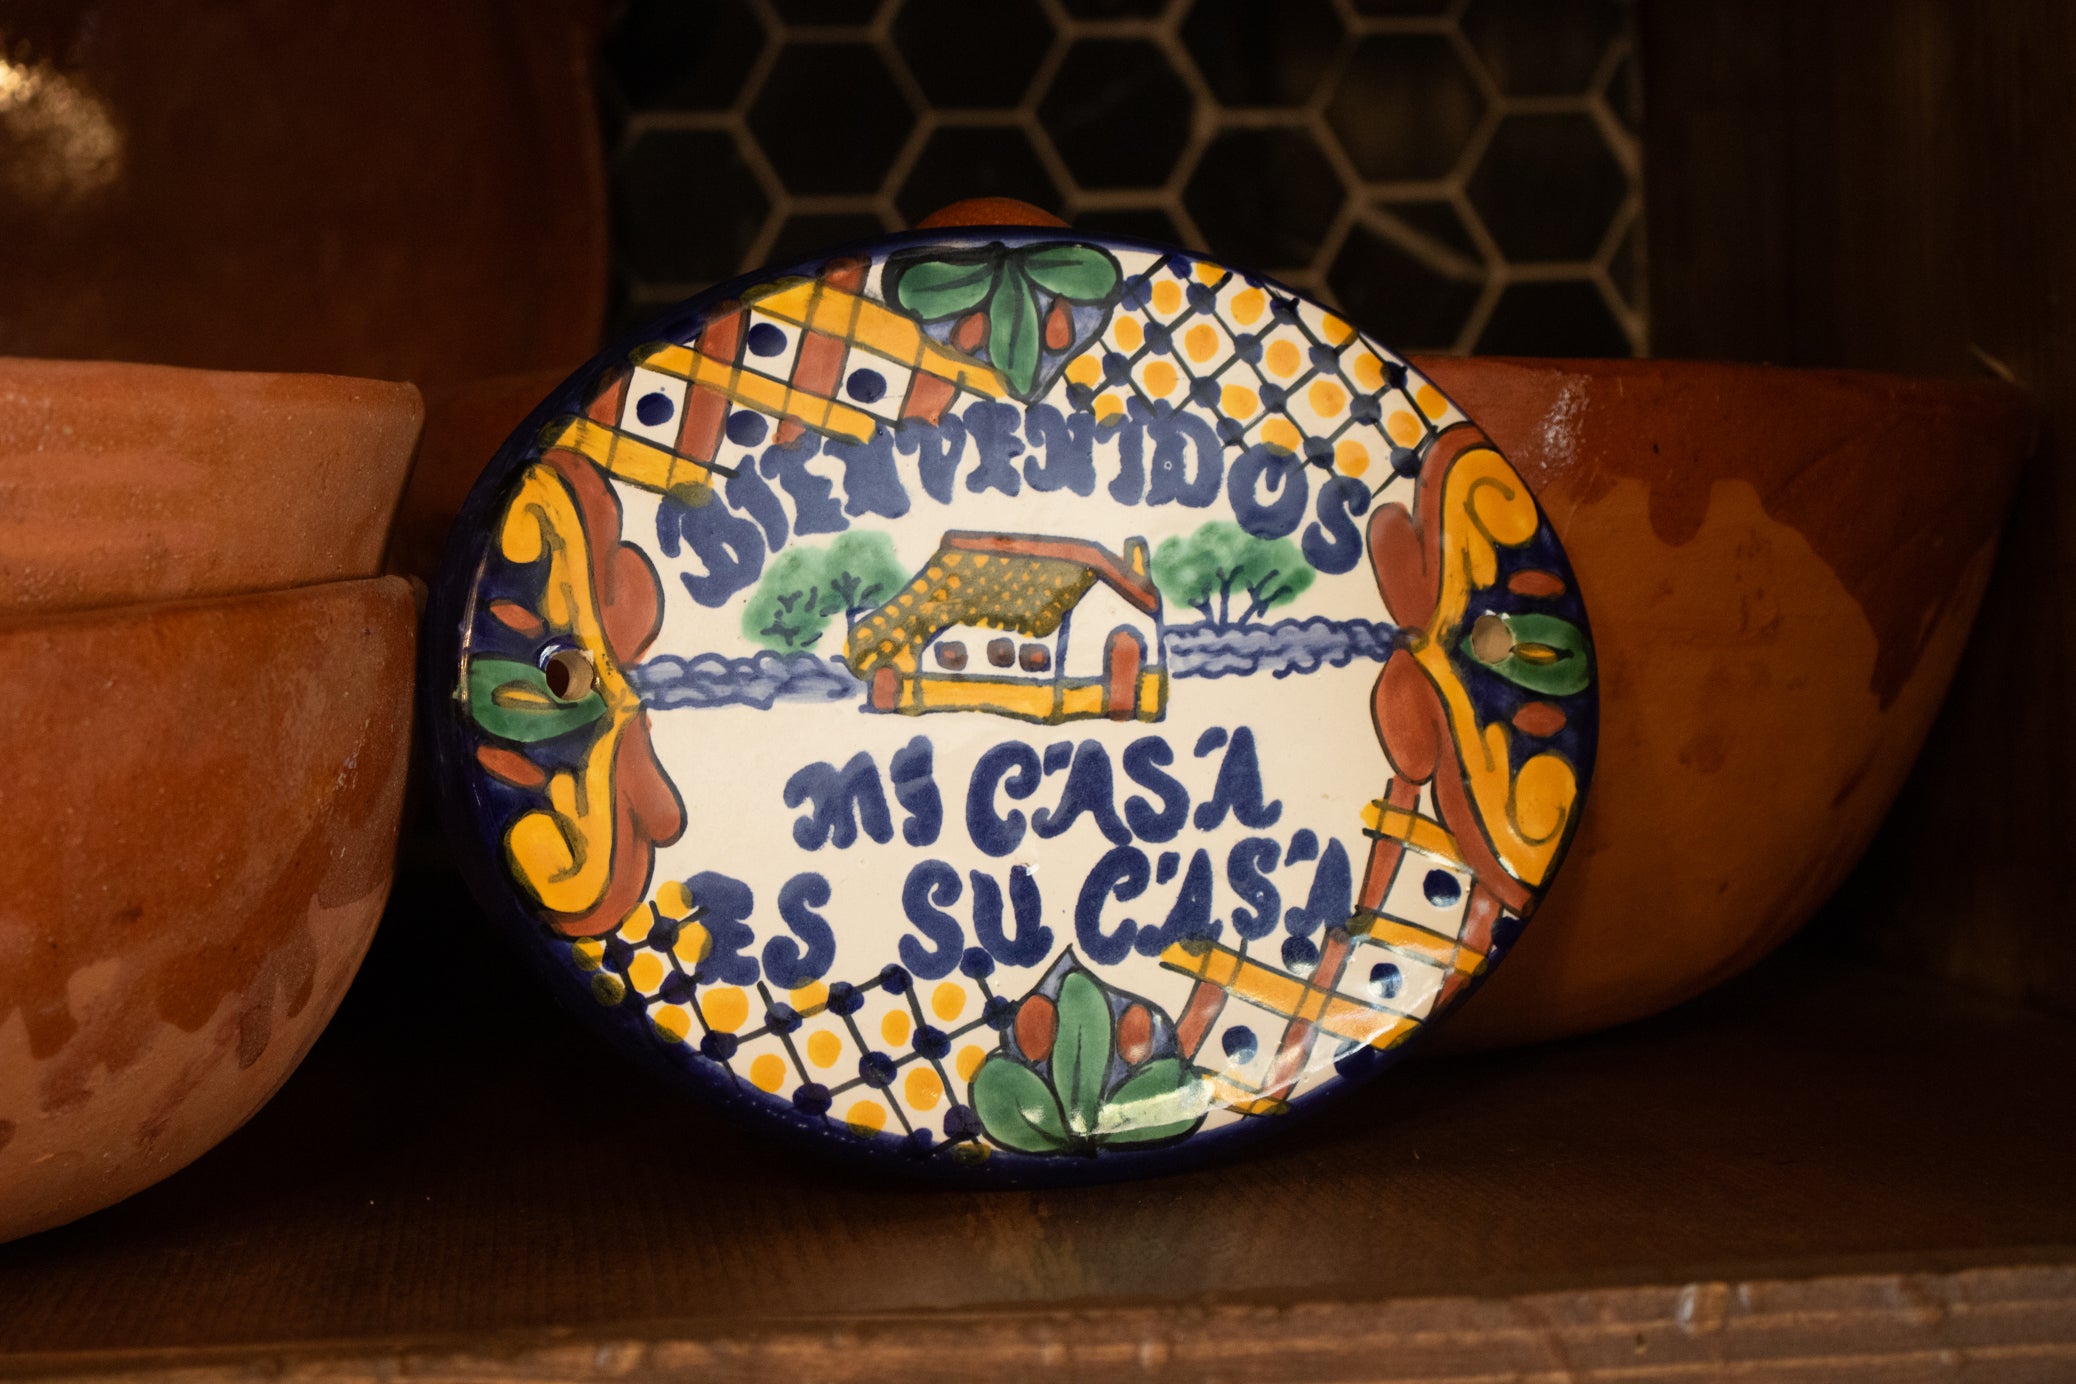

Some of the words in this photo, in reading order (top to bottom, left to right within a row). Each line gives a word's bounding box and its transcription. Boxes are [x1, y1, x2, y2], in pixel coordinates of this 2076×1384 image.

[656, 398, 1371, 607] BIENVENIDOS
[783, 735, 942, 851] MI
[966, 726, 1282, 857] CASA
[684, 870, 836, 988] ES
[899, 859, 1054, 980] SU
[1074, 828, 1353, 967] CASA
